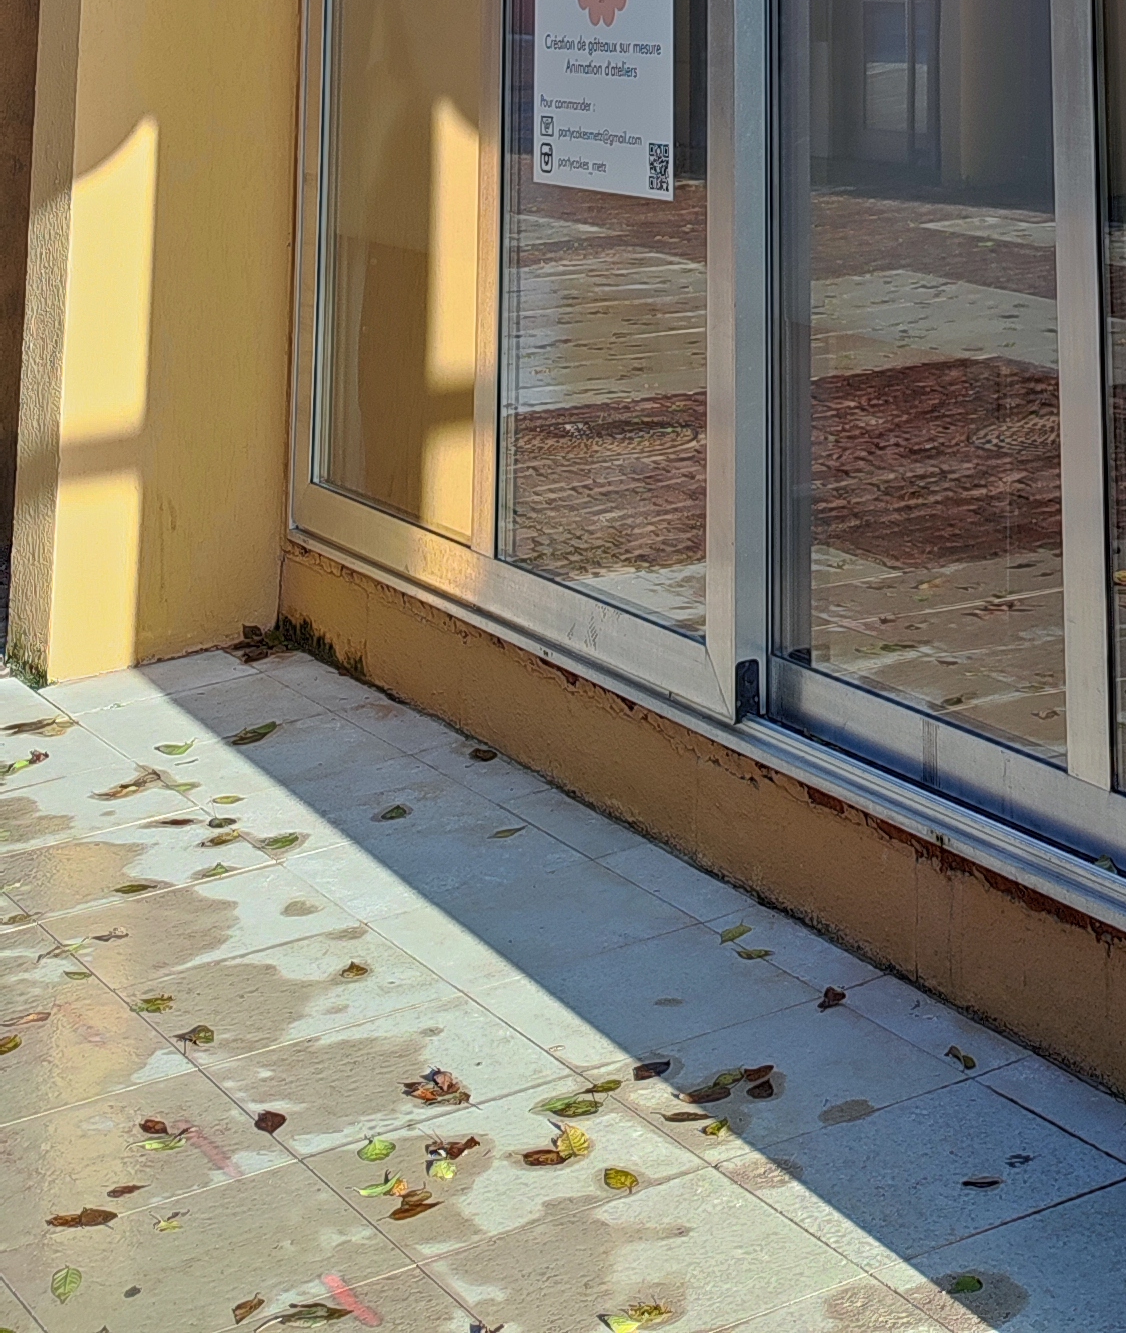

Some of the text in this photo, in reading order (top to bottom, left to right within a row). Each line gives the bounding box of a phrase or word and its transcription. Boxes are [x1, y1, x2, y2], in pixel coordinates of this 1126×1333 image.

[544, 33, 662, 56] Création de gâteaux sur mesure
[565, 58, 638, 78] Animation d'ateliers
[540, 94, 554, 109] Pour
[554, 97, 592, 112] commander
[558, 126, 643, 147] partycakesmetz@gmail.com
